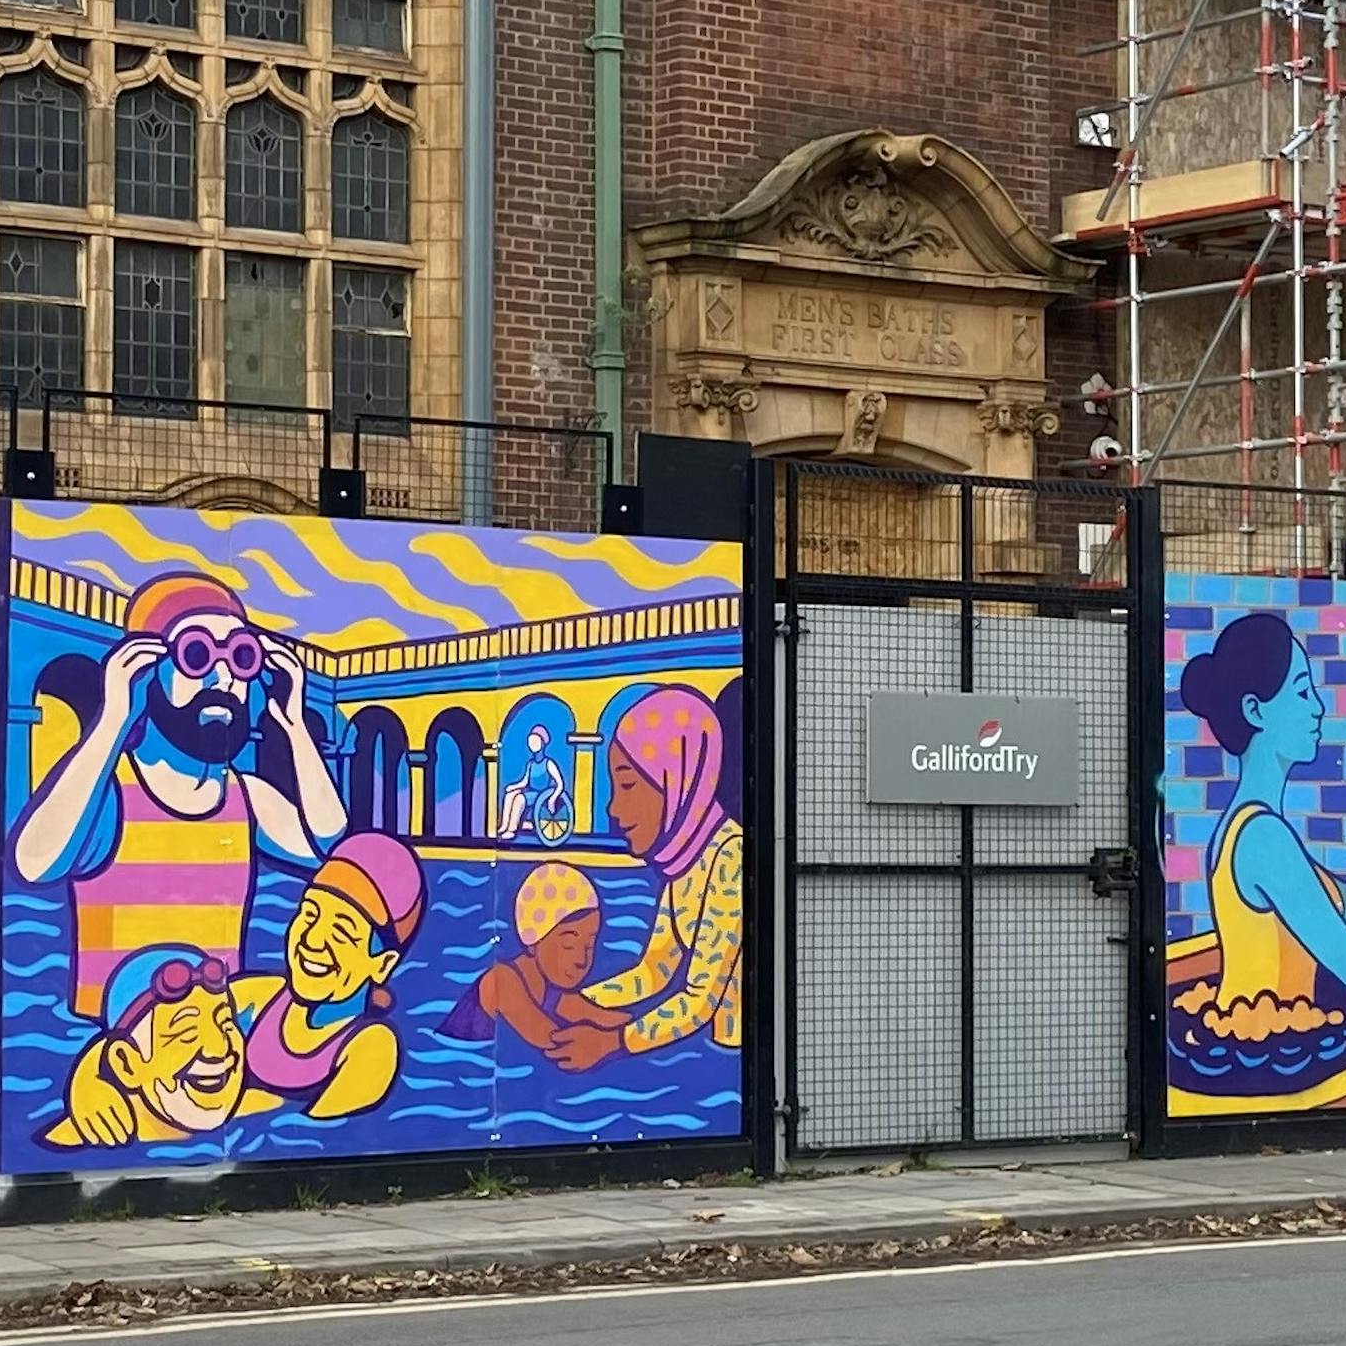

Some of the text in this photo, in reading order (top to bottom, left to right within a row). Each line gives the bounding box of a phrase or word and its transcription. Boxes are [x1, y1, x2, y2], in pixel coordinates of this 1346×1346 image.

[777, 291, 955, 336] MEN'S BATHS
[772, 323, 964, 367] FIRST CLASS
[911, 744, 1039, 780] GallifordTry
